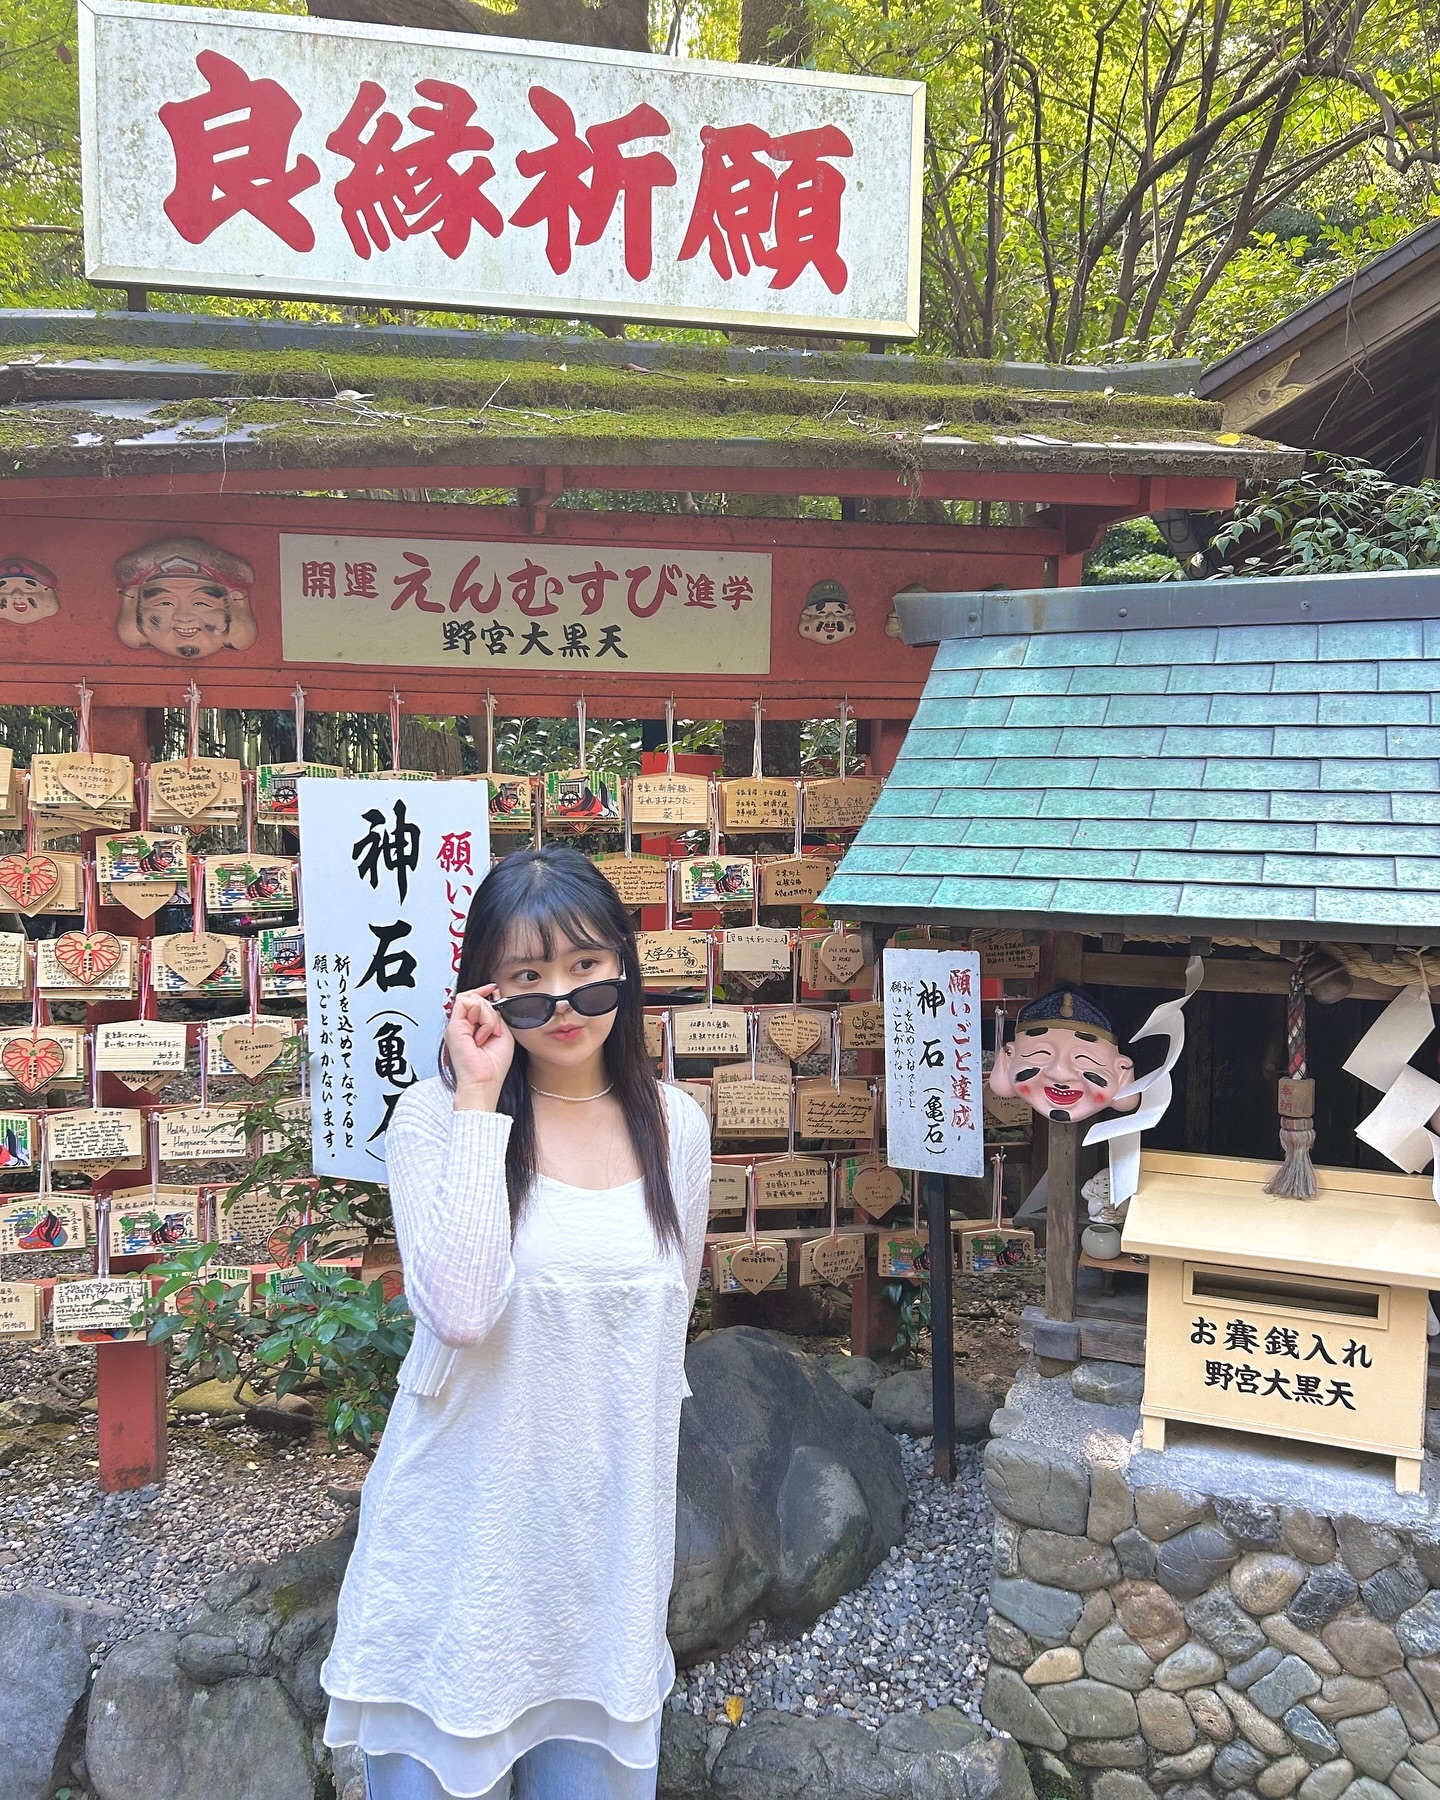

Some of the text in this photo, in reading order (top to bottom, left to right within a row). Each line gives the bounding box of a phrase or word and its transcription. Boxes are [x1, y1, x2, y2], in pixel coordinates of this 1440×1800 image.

[158, 48, 854, 296] 良縁祈願
[302, 551, 753, 618] 開運 えんむすび 進学
[442, 620, 629, 658] 野宮大黒天
[333, 953, 359, 1149] 祈りを込めてなでると
[915, 979, 948, 1155] 神石（亀石）
[946, 968, 975, 1131] 願いごと達成
[1280, 1083, 1293, 1113] 奉納
[1190, 1316, 1373, 1368] お賽銭入れ
[1203, 1359, 1357, 1411] 野宮大黒天
